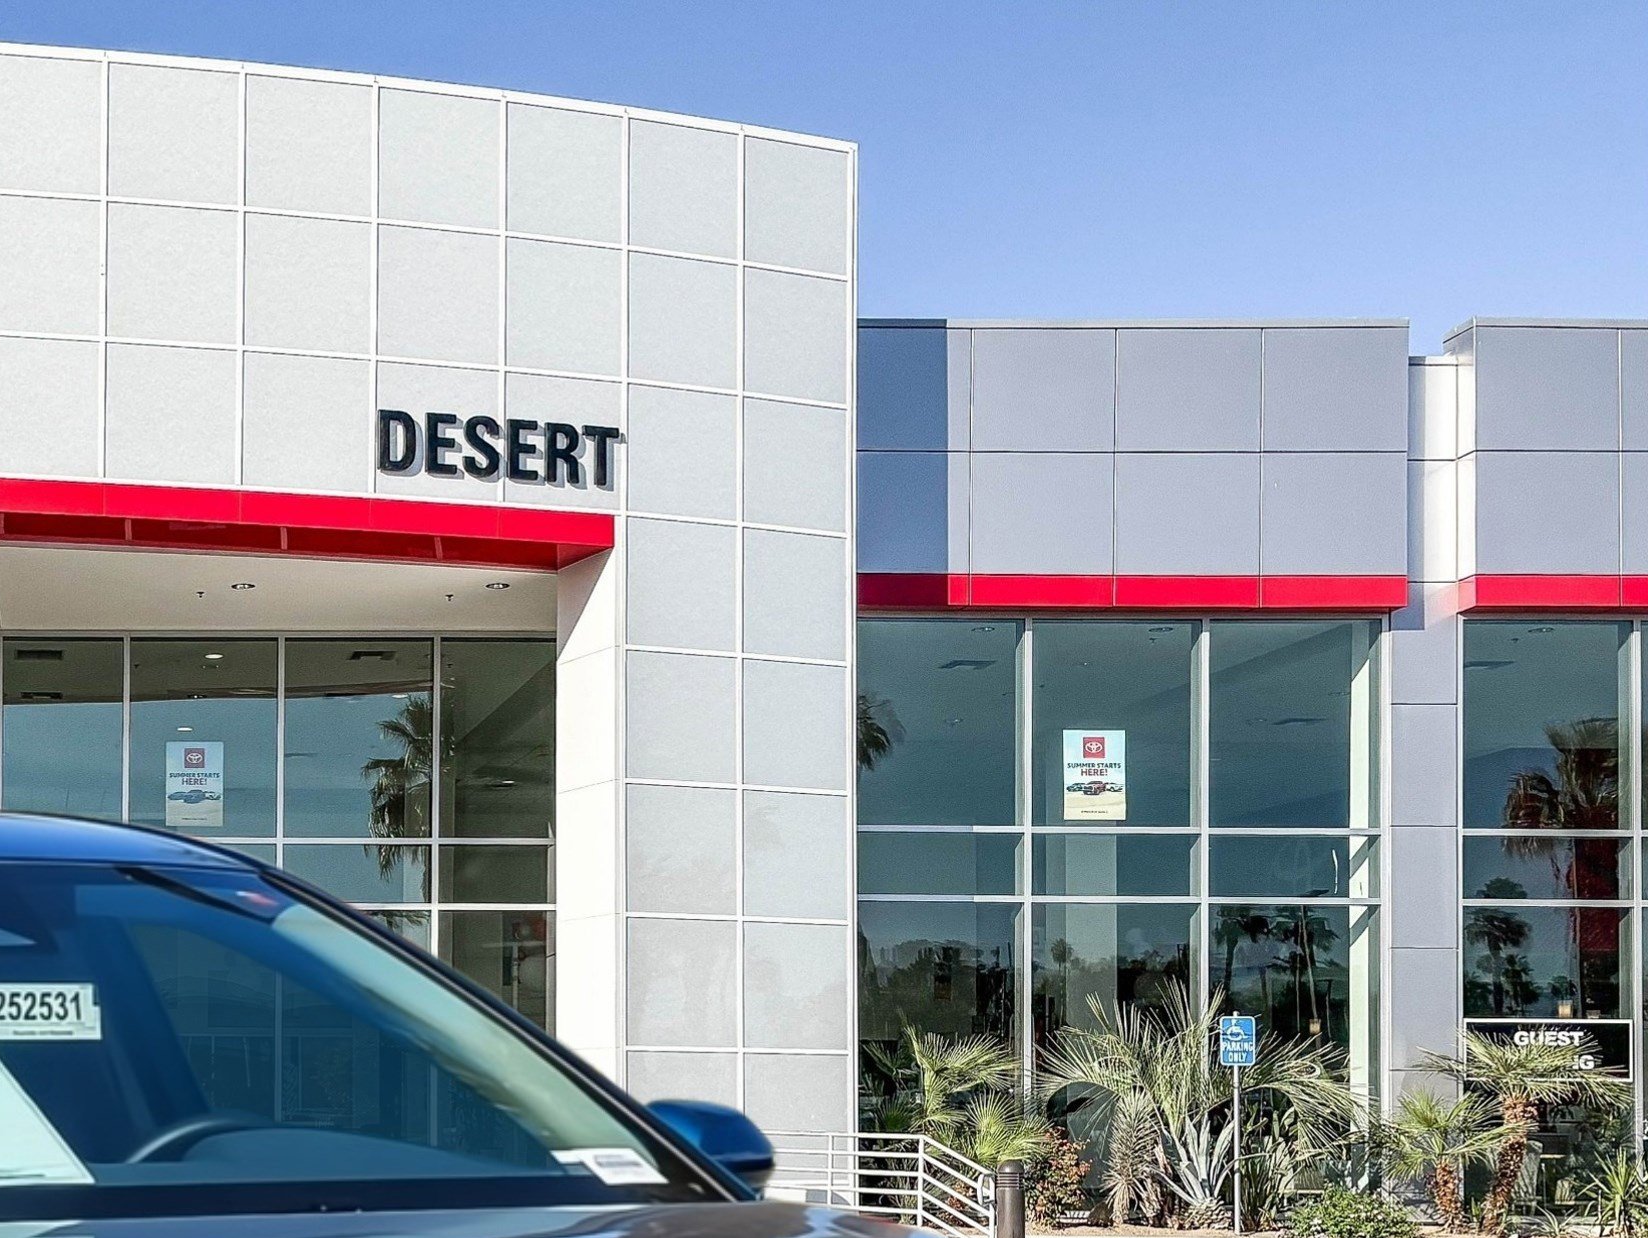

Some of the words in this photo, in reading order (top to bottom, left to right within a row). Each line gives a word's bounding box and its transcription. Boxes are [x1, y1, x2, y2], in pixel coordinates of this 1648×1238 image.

[377, 409, 620, 487] DESERT
[181, 778, 208, 786] HERE!
[1513, 1030, 1584, 1047] GUEST
[1222, 1041, 1253, 1051] PARKING
[1229, 1051, 1247, 1062] ONLY
